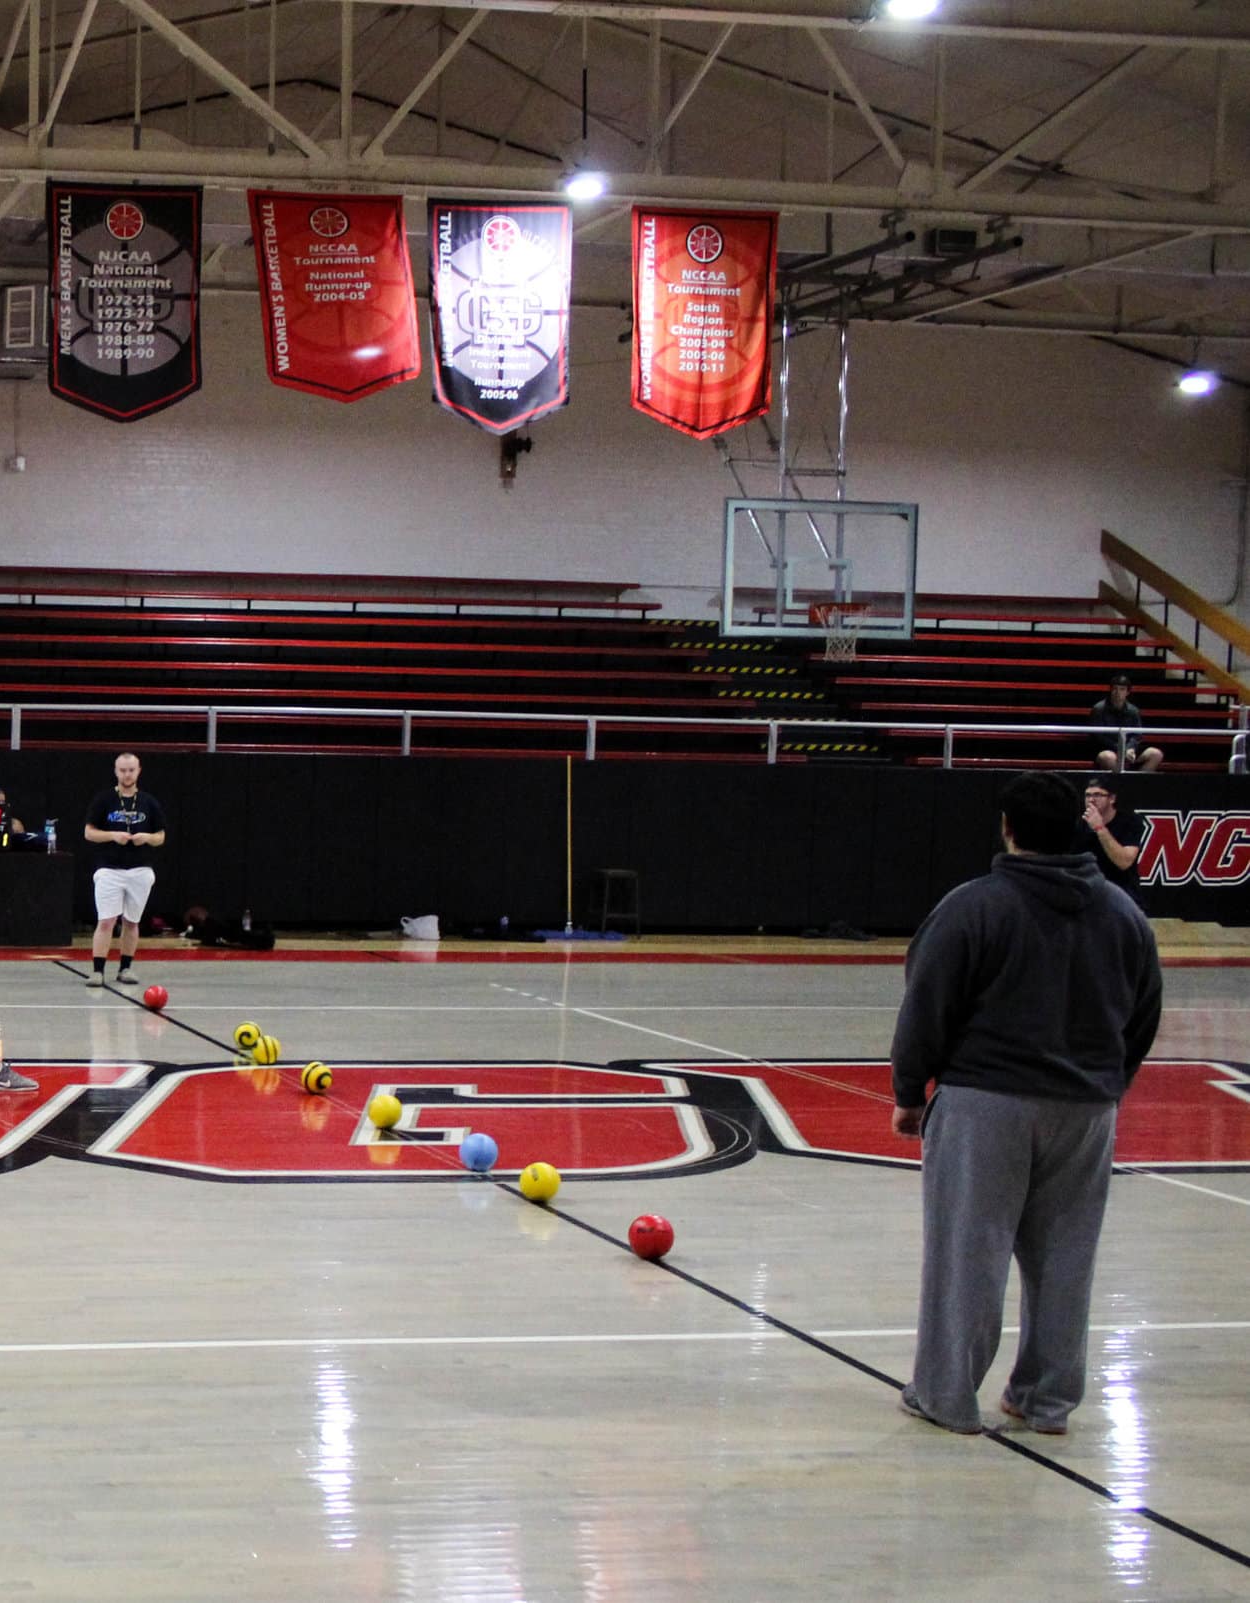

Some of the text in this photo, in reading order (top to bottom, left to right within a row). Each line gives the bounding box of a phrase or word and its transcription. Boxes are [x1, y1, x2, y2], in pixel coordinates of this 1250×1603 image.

[60, 195, 72, 301] BASKETBALL
[309, 243, 358, 252] NCCAA
[98, 250, 152, 262] NJCAA
[294, 255, 376, 266] Tournament
[439, 212, 452, 314] KETBALL
[93, 264, 158, 276] National
[310, 269, 365, 280] National
[681, 270, 727, 282] NCCAA
[78, 276, 172, 289] Tournament
[262, 202, 290, 372] WOMEN'S BASKETBALL
[304, 281, 372, 292] Runner-up
[667, 283, 742, 297] Tournament
[98, 295, 155, 306] 1972-73
[314, 292, 366, 302] 2004-05
[686, 302, 720, 313] South
[682, 314, 724, 326] Region
[98, 321, 155, 332] 1976-77
[670, 326, 735, 338] Champions
[98, 334, 155, 346] 1988-89
[98, 348, 155, 360] 1989-90
[480, 389, 518, 400] 2005-06
